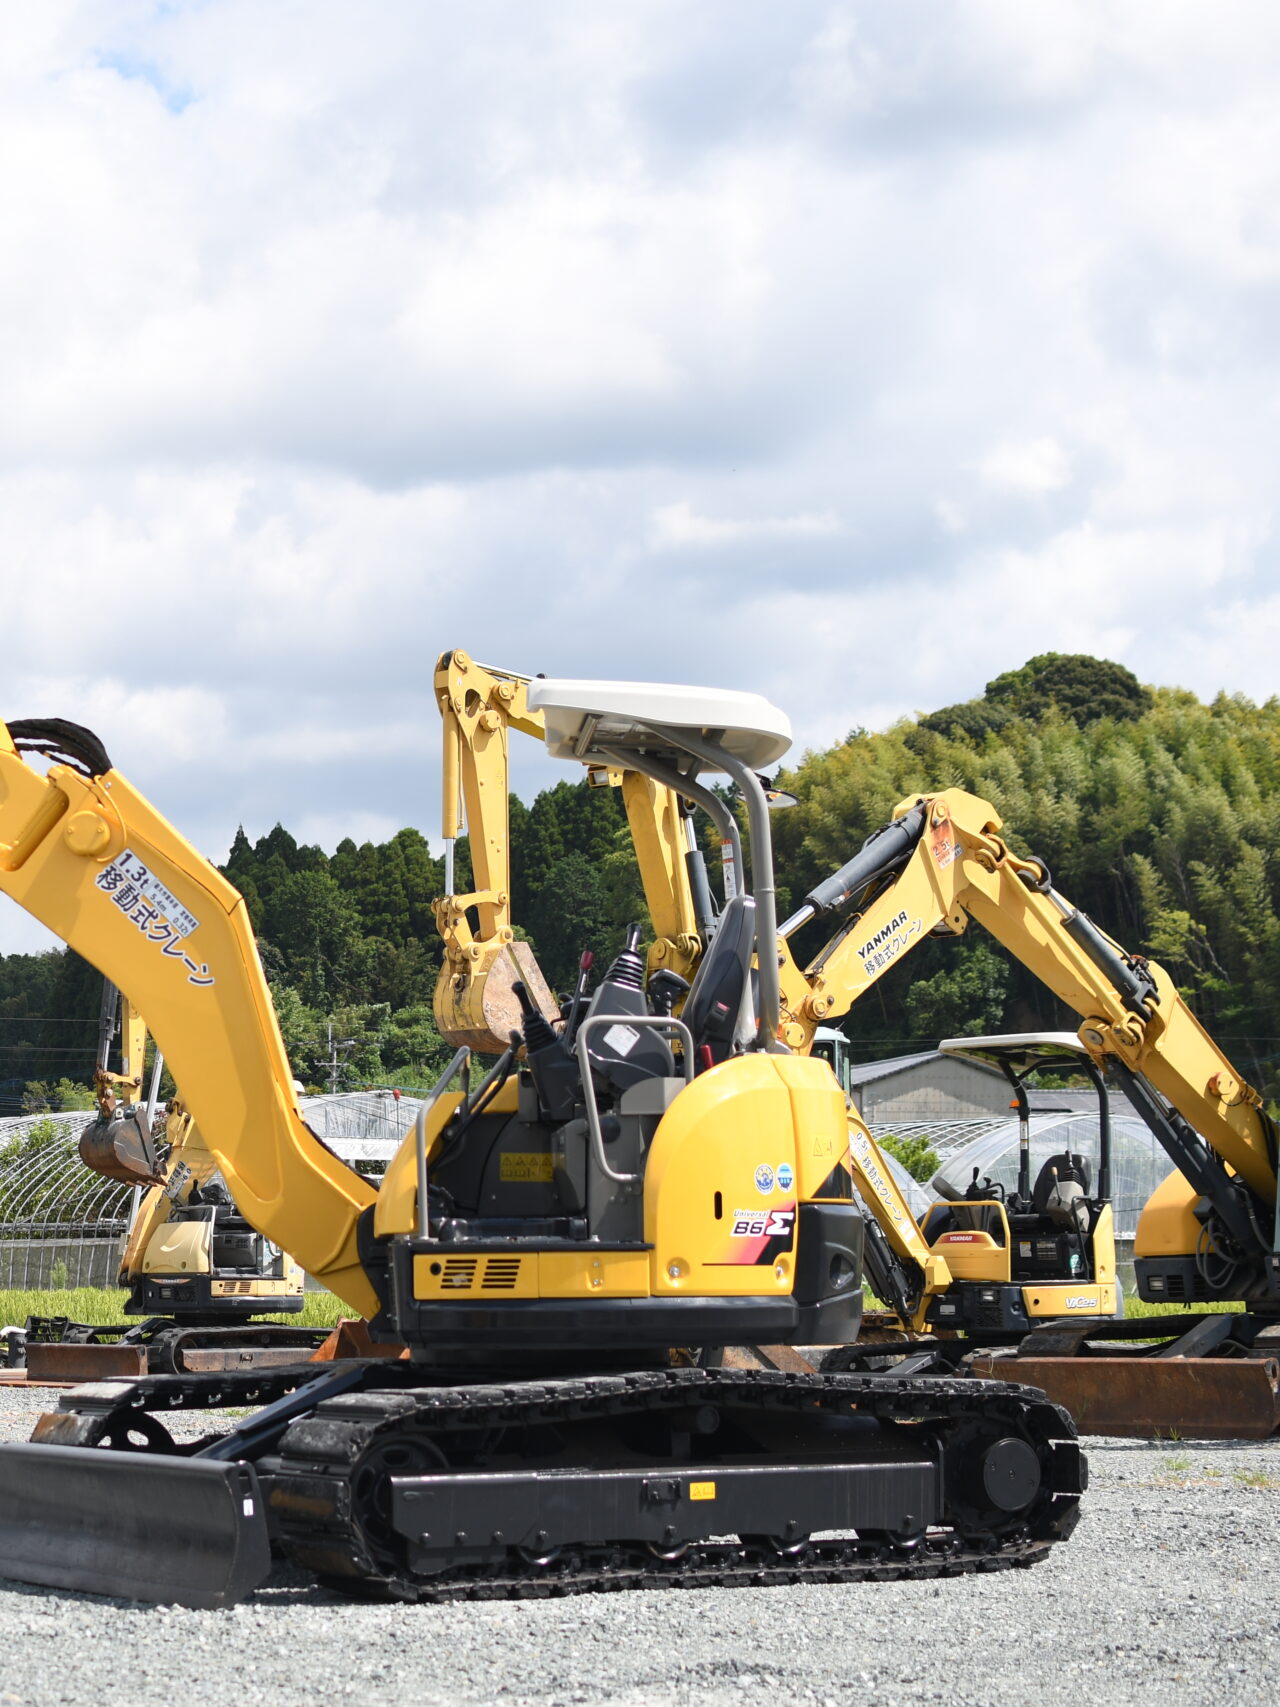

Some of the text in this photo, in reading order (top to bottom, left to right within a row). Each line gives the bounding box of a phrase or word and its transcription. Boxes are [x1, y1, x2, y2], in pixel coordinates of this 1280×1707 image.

[118, 852, 150, 889] 1.3t
[96, 865, 214, 985] 移動式クレーン
[858, 911, 908, 959] YANMAR
[864, 919, 922, 976] 移動式クレーン
[862, 1156, 903, 1221] 移動式クレーン
